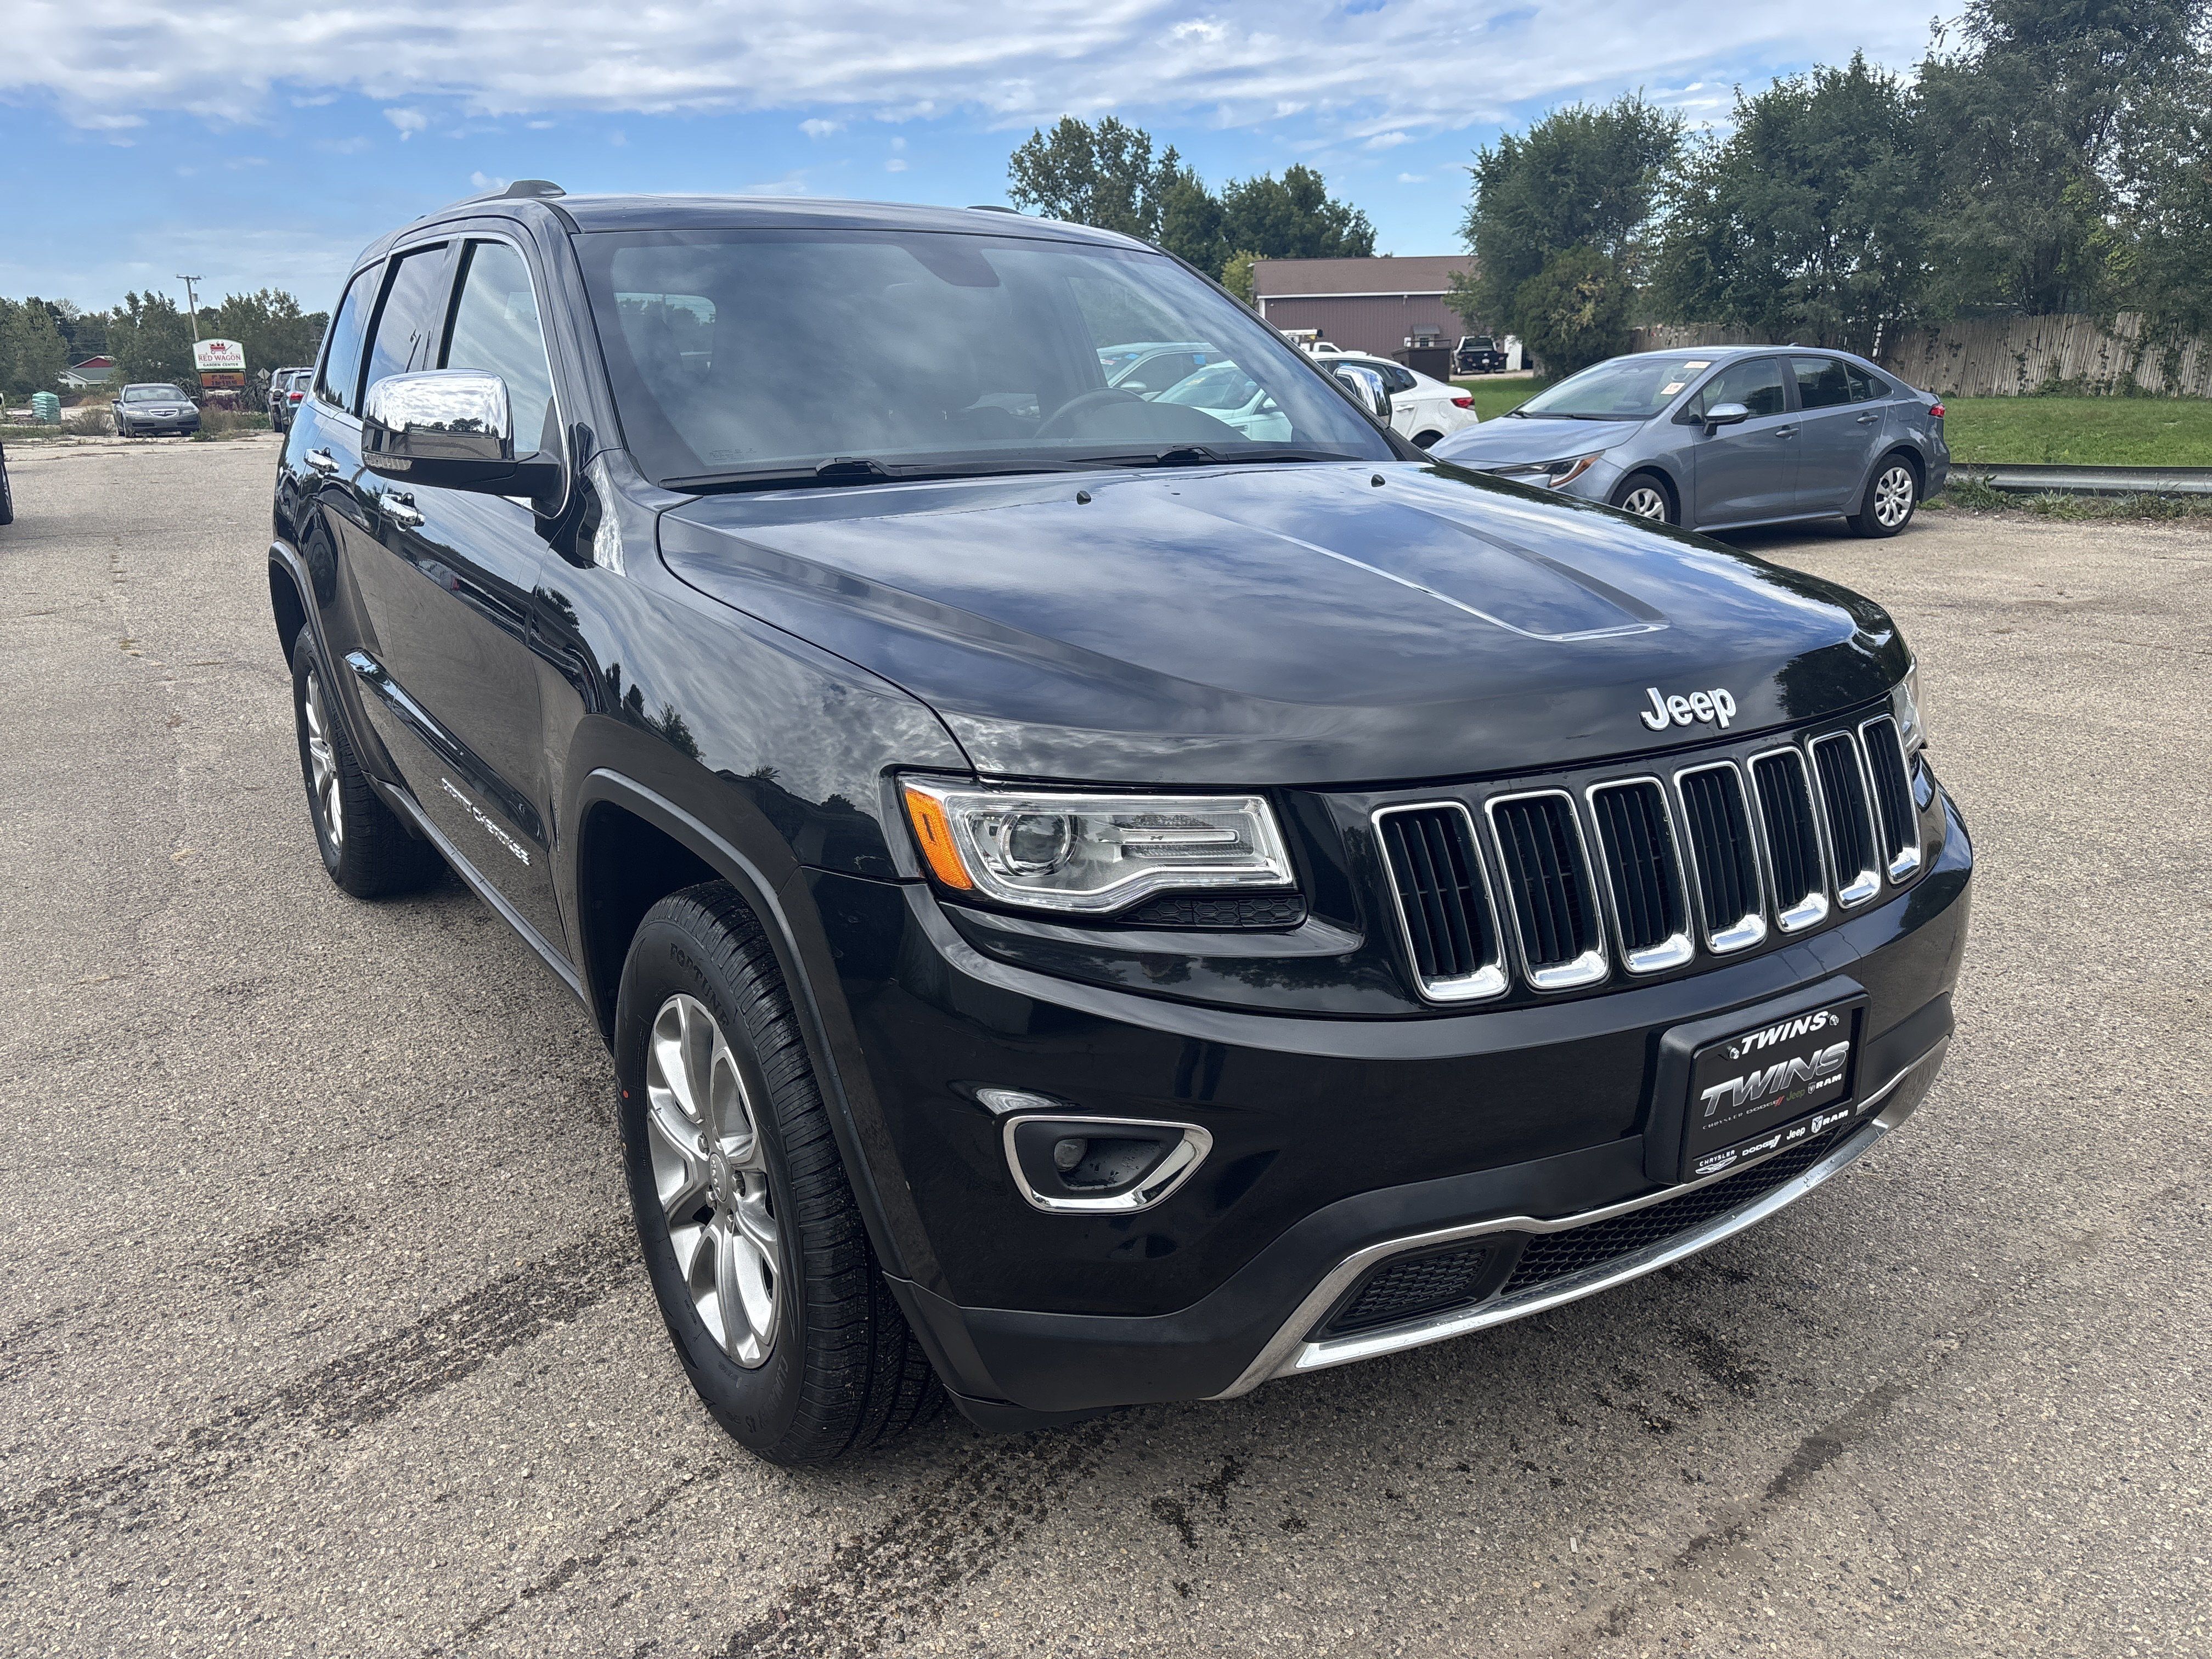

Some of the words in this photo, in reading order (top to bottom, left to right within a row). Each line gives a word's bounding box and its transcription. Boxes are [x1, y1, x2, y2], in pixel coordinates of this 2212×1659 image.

[1639, 687, 1736, 731] Jeep
[1741, 1011, 1829, 1056] TWINS
[1700, 1040, 1850, 1118] TWINS
[1786, 1088, 1805, 1101] Jeep
[1816, 1073, 1842, 1089] RAM
[1699, 1149, 1735, 1167] CHRYSLER
[1742, 1138, 1776, 1156] DODGE
[1786, 1127, 1805, 1141] Jeep
[1822, 1109, 1849, 1126] RAM
